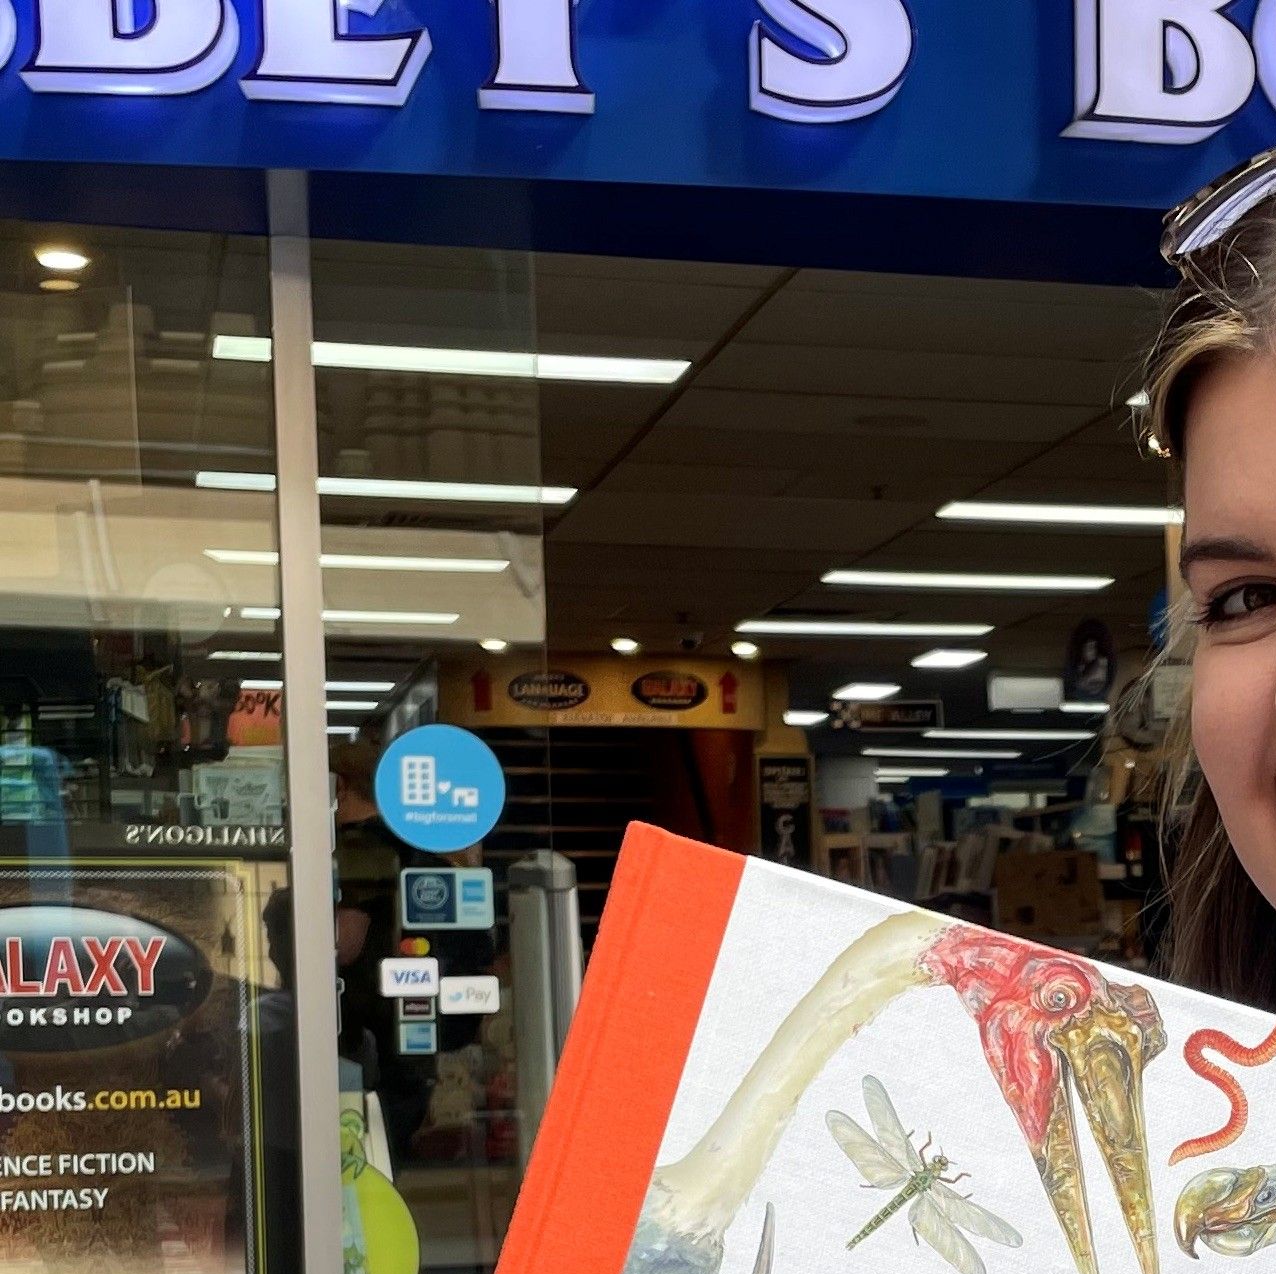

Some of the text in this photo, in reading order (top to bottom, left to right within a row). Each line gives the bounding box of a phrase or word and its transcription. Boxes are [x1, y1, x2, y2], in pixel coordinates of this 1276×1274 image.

[0, 936, 167, 998] LAXY
[393, 969, 431, 985] VISA
[466, 987, 492, 1004] Pay
[0, 1006, 133, 1027] OKSHOP
[0, 1152, 155, 1178] NCE FICTION
[1, 1187, 109, 1212] FANTASY
